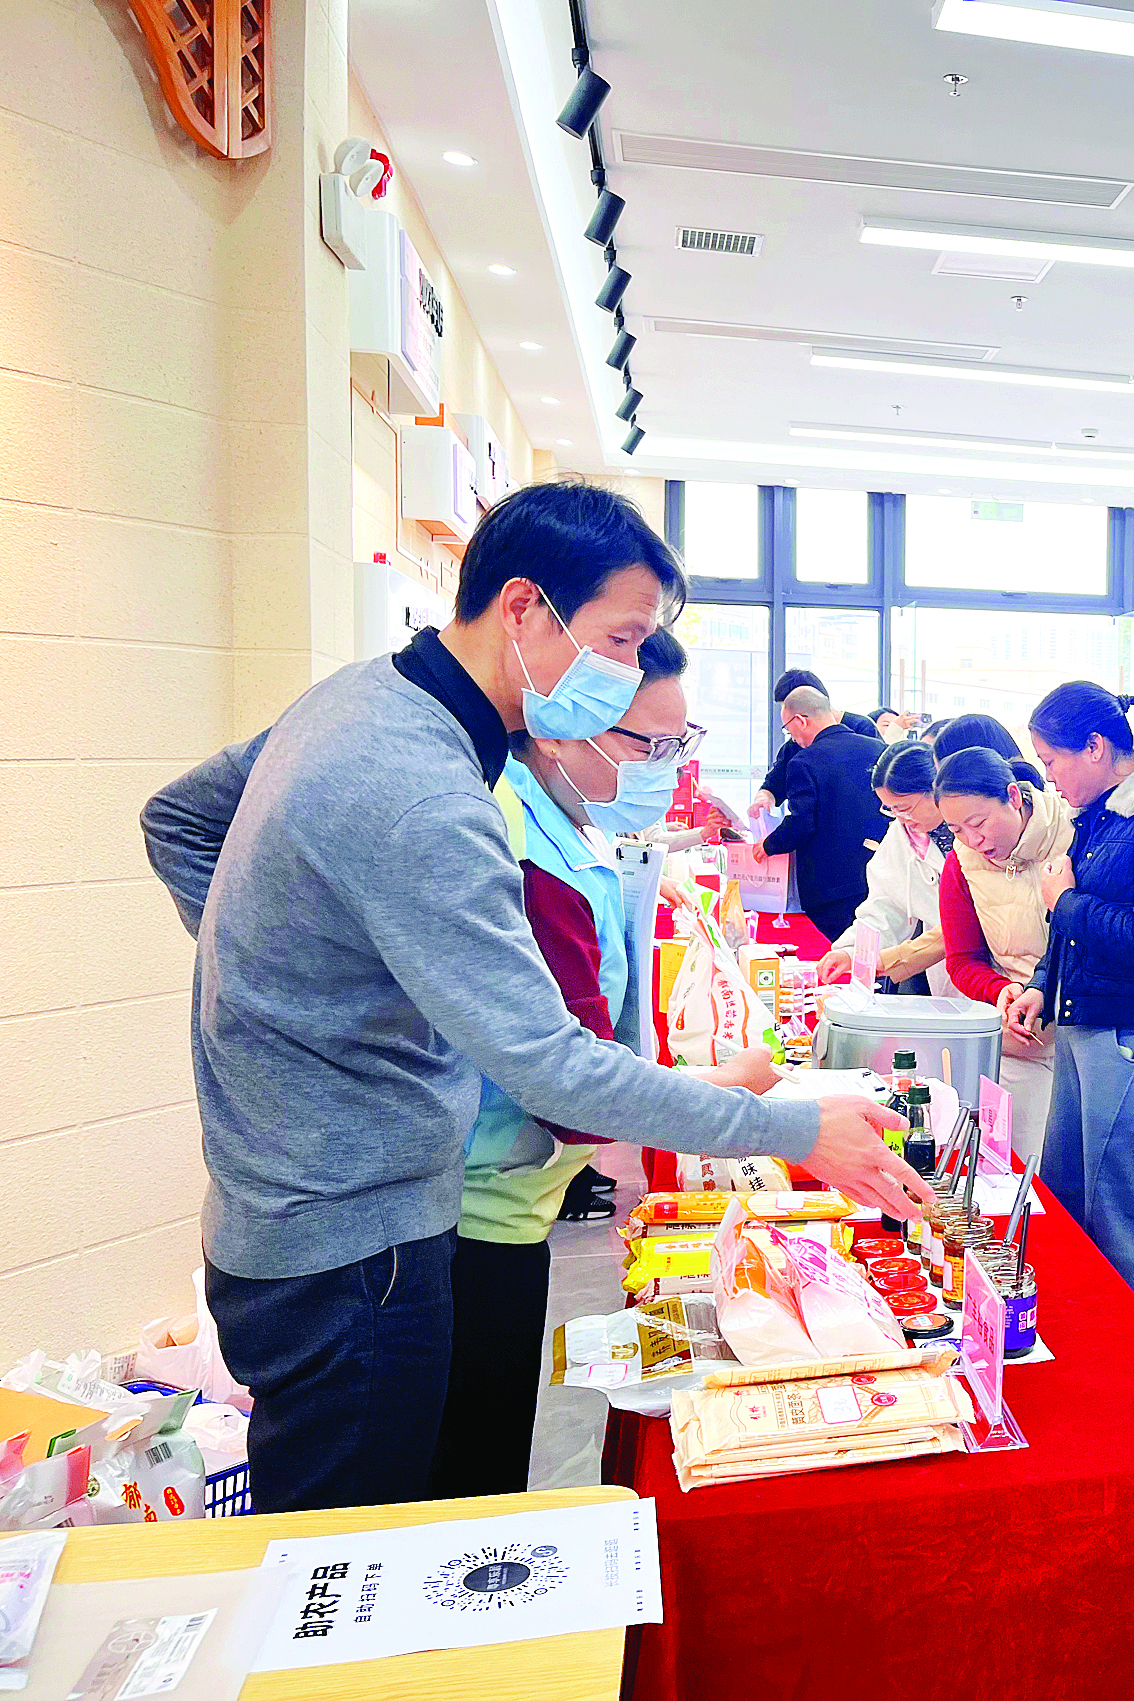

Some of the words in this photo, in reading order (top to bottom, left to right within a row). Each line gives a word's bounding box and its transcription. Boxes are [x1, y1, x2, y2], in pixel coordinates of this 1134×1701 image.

[786, 1391, 807, 1425] 黄皮面条
[292, 1561, 352, 1640] 助农产品
[353, 1562, 384, 1623] 自动扫码下单
